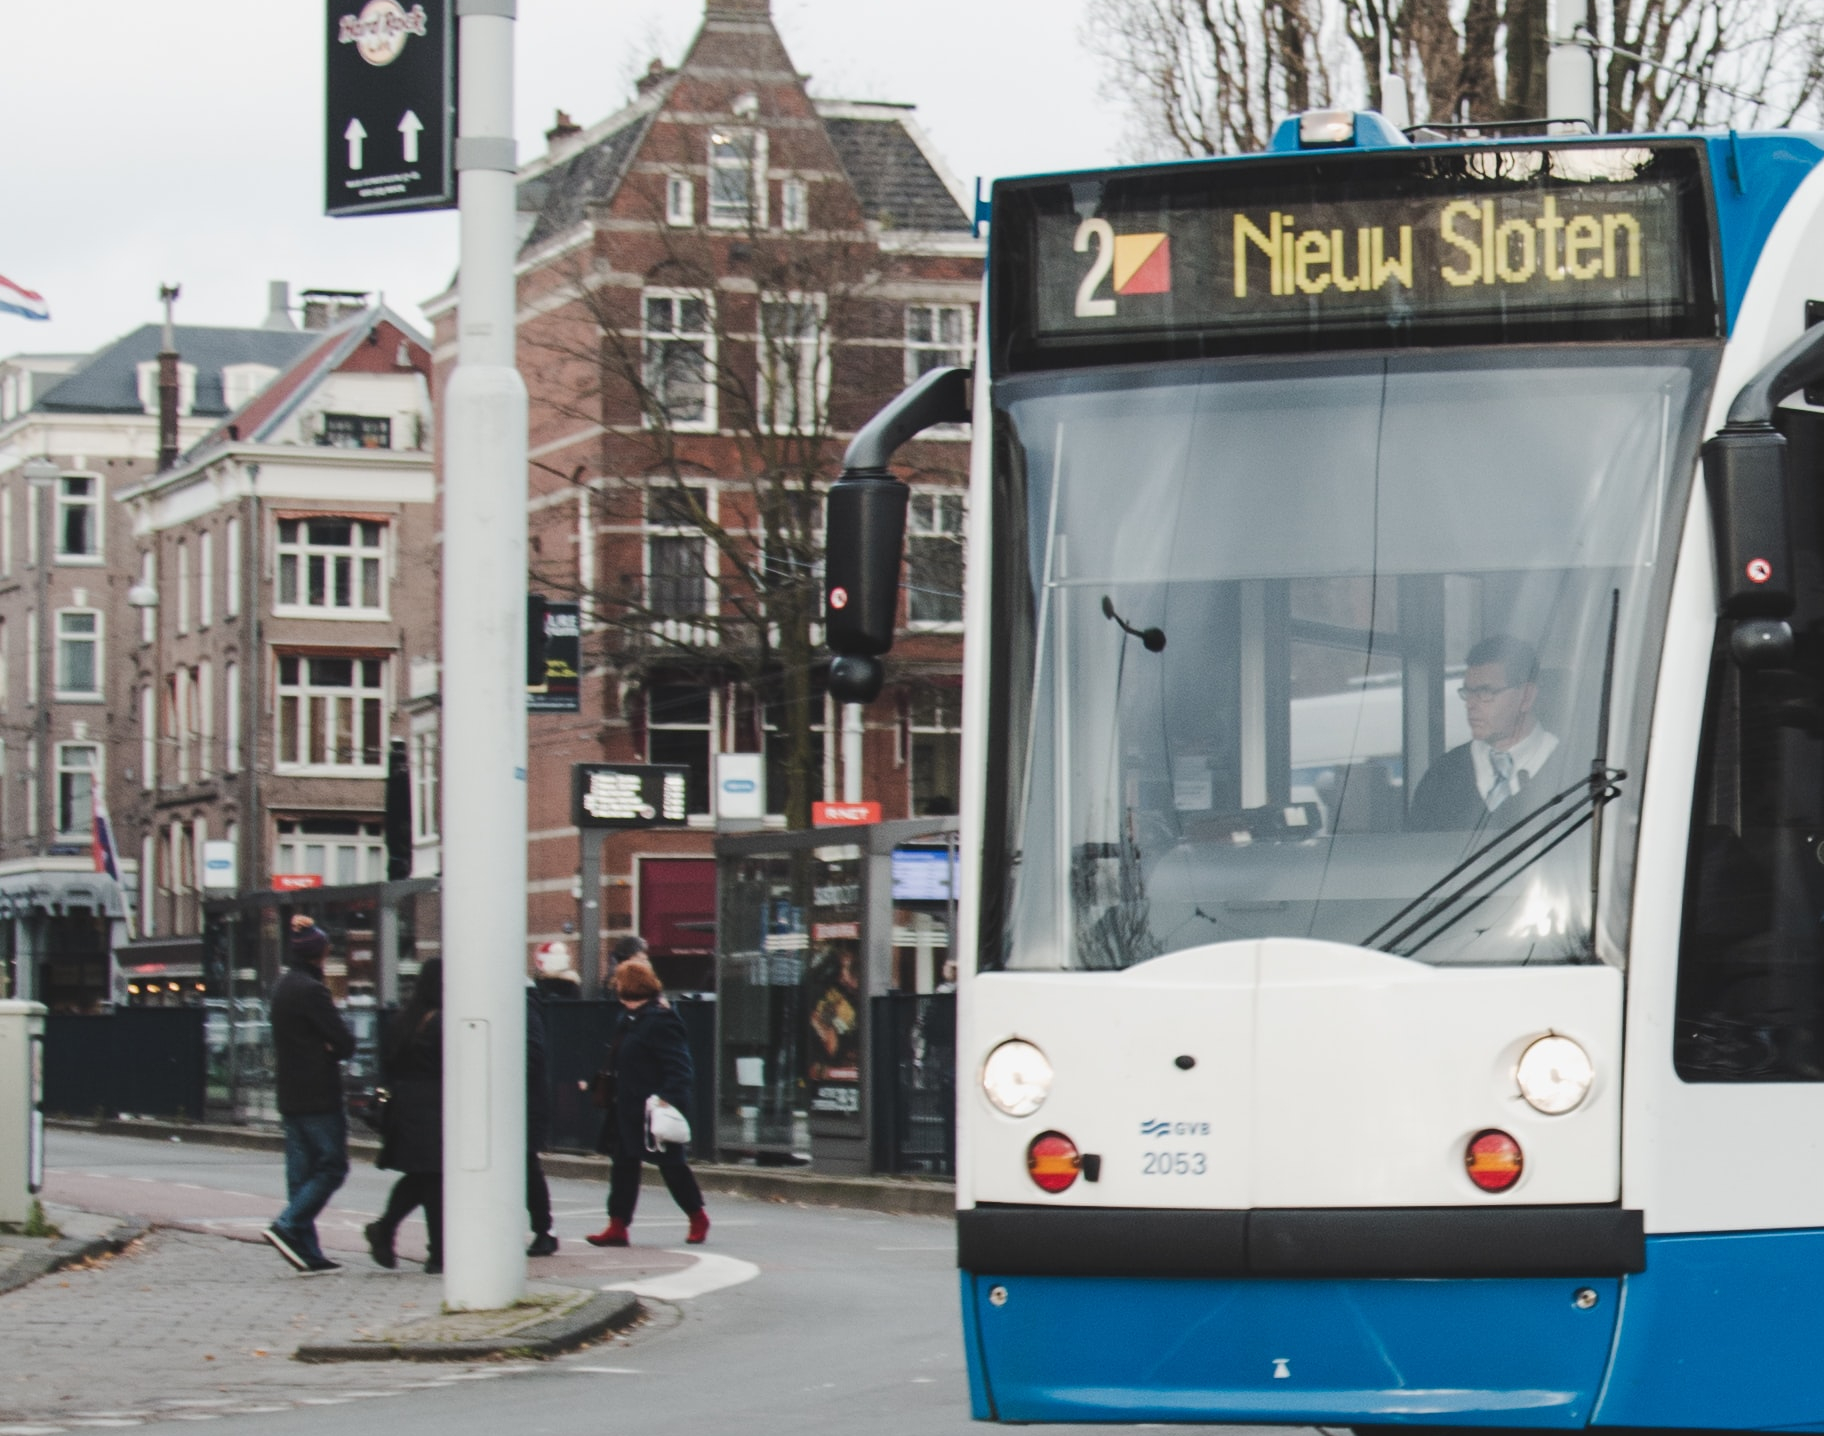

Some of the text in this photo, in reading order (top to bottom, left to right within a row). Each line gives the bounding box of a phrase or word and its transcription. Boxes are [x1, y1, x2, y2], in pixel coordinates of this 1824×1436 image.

[1073, 195, 1642, 317] 2 Nieuw Sloten
[1175, 1121, 1210, 1136] GVB
[1142, 1151, 1207, 1175] 2053
